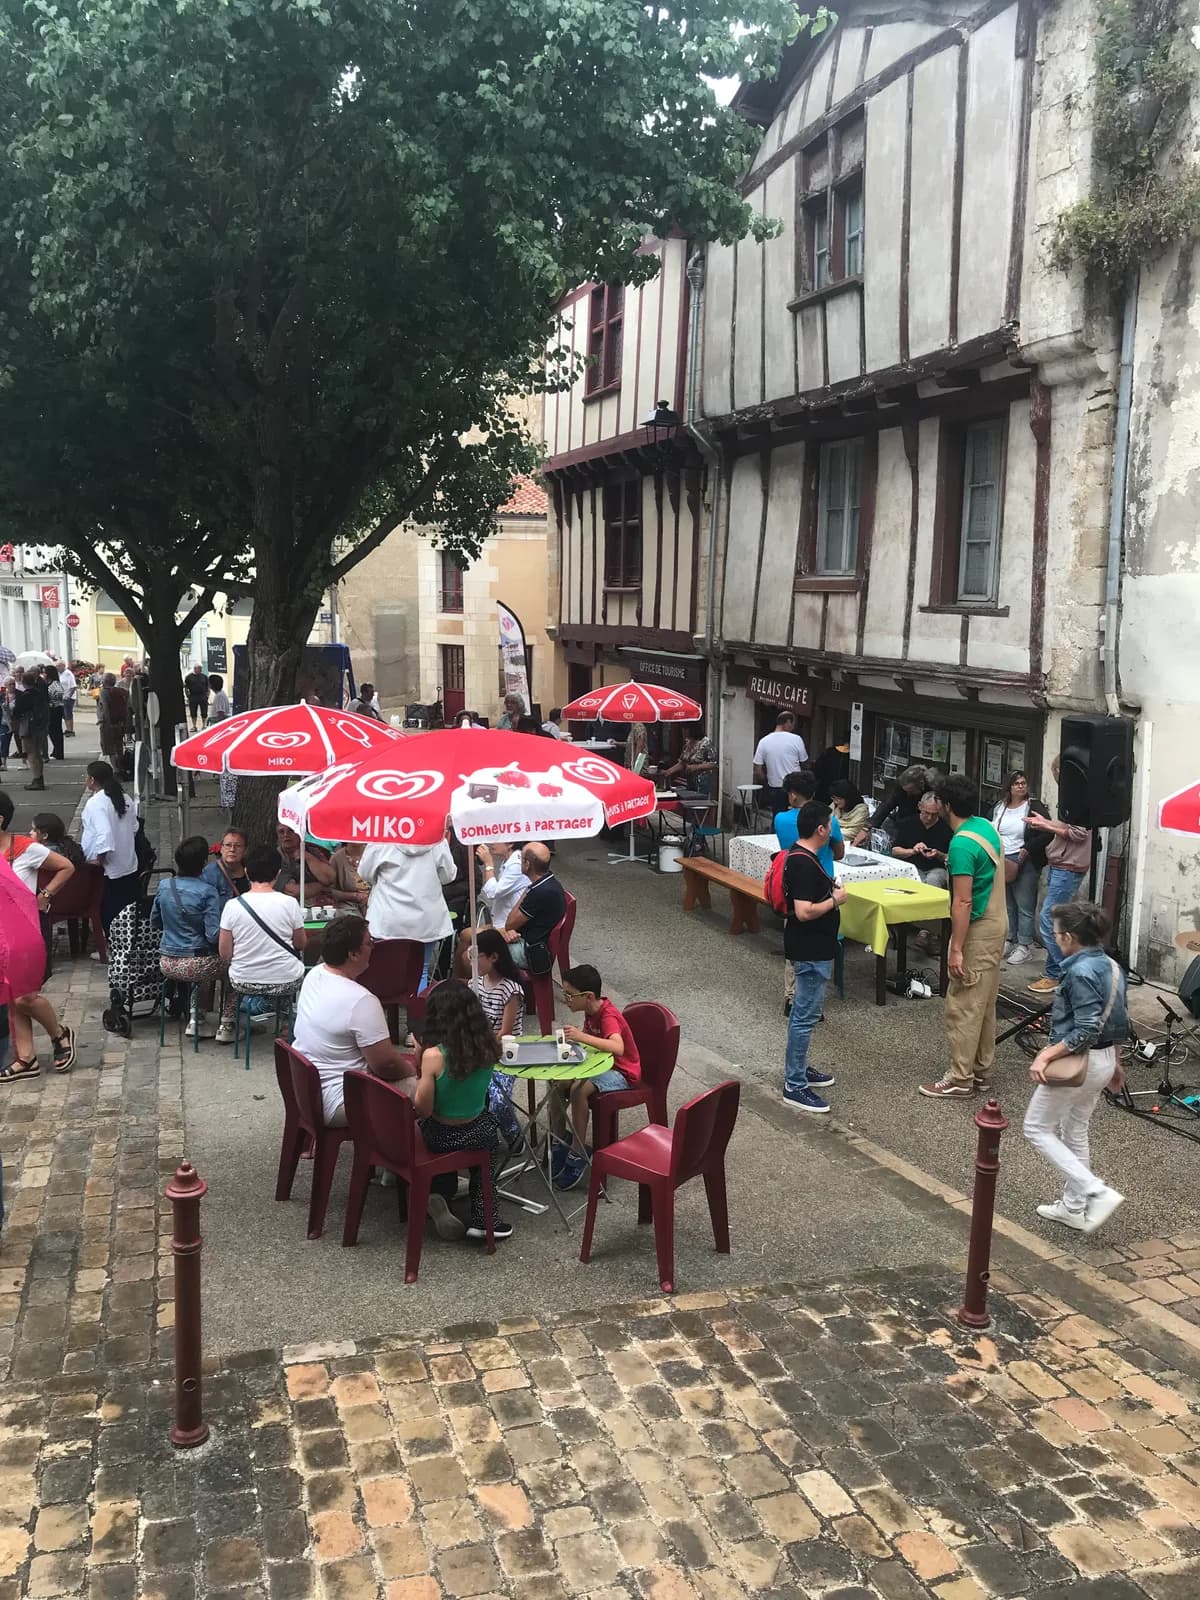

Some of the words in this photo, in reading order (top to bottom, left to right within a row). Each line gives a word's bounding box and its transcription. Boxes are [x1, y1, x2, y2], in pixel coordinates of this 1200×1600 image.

[640, 662, 655, 674] OFFICE
[655, 664, 662, 675] DE
[662, 665, 685, 679] TOURISME
[750, 677, 781, 697] RELAIS
[784, 685, 808, 705] CAFÉ
[268, 757, 293, 766] MIKO
[352, 815, 416, 839] MIKO
[461, 821, 521, 838] Bonheurs
[525, 821, 531, 832] à
